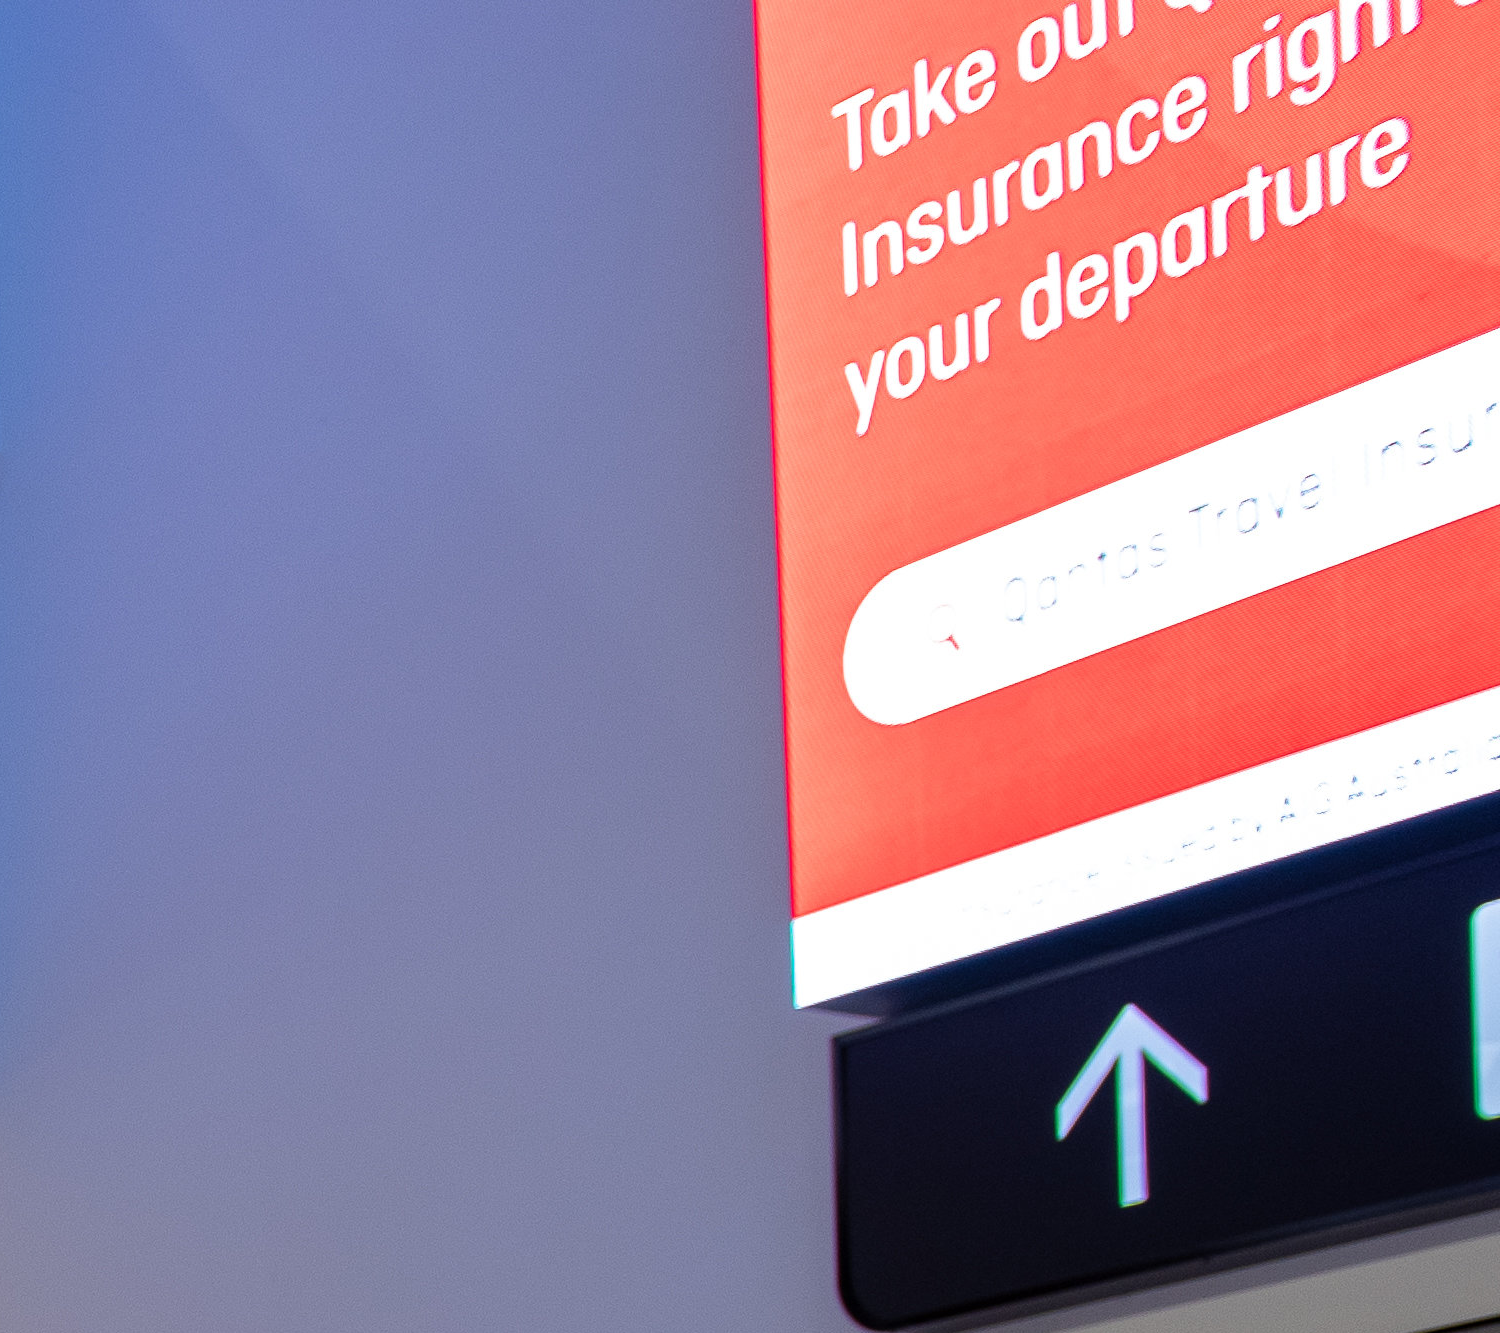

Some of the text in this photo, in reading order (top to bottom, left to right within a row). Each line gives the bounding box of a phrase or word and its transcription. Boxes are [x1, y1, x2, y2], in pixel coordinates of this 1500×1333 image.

[831, 47, 998, 171] Take
[842, 75, 1209, 297] Insurance
[844, 116, 1412, 437] your departure
